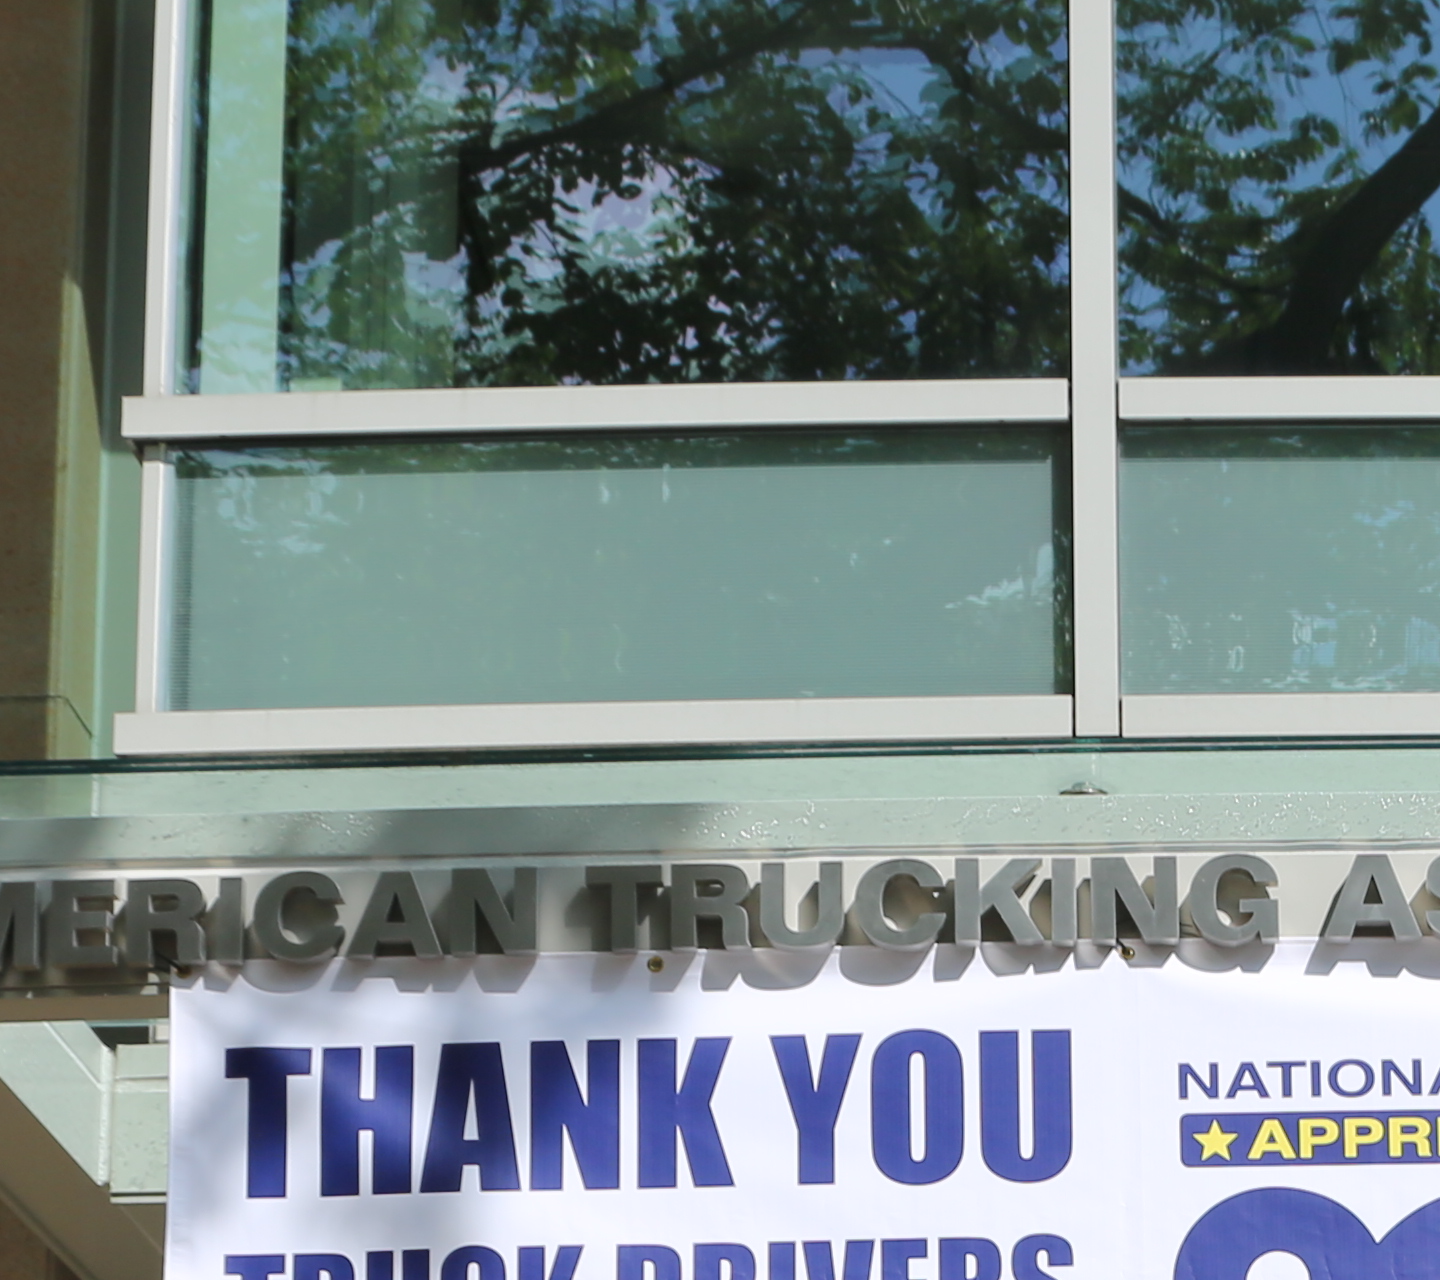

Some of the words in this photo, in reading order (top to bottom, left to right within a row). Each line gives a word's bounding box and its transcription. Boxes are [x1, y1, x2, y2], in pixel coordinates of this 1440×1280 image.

[585, 853, 1281, 954] TRUCKING
[225, 1038, 734, 1198] THANK
[771, 1030, 1072, 1185] YOU
